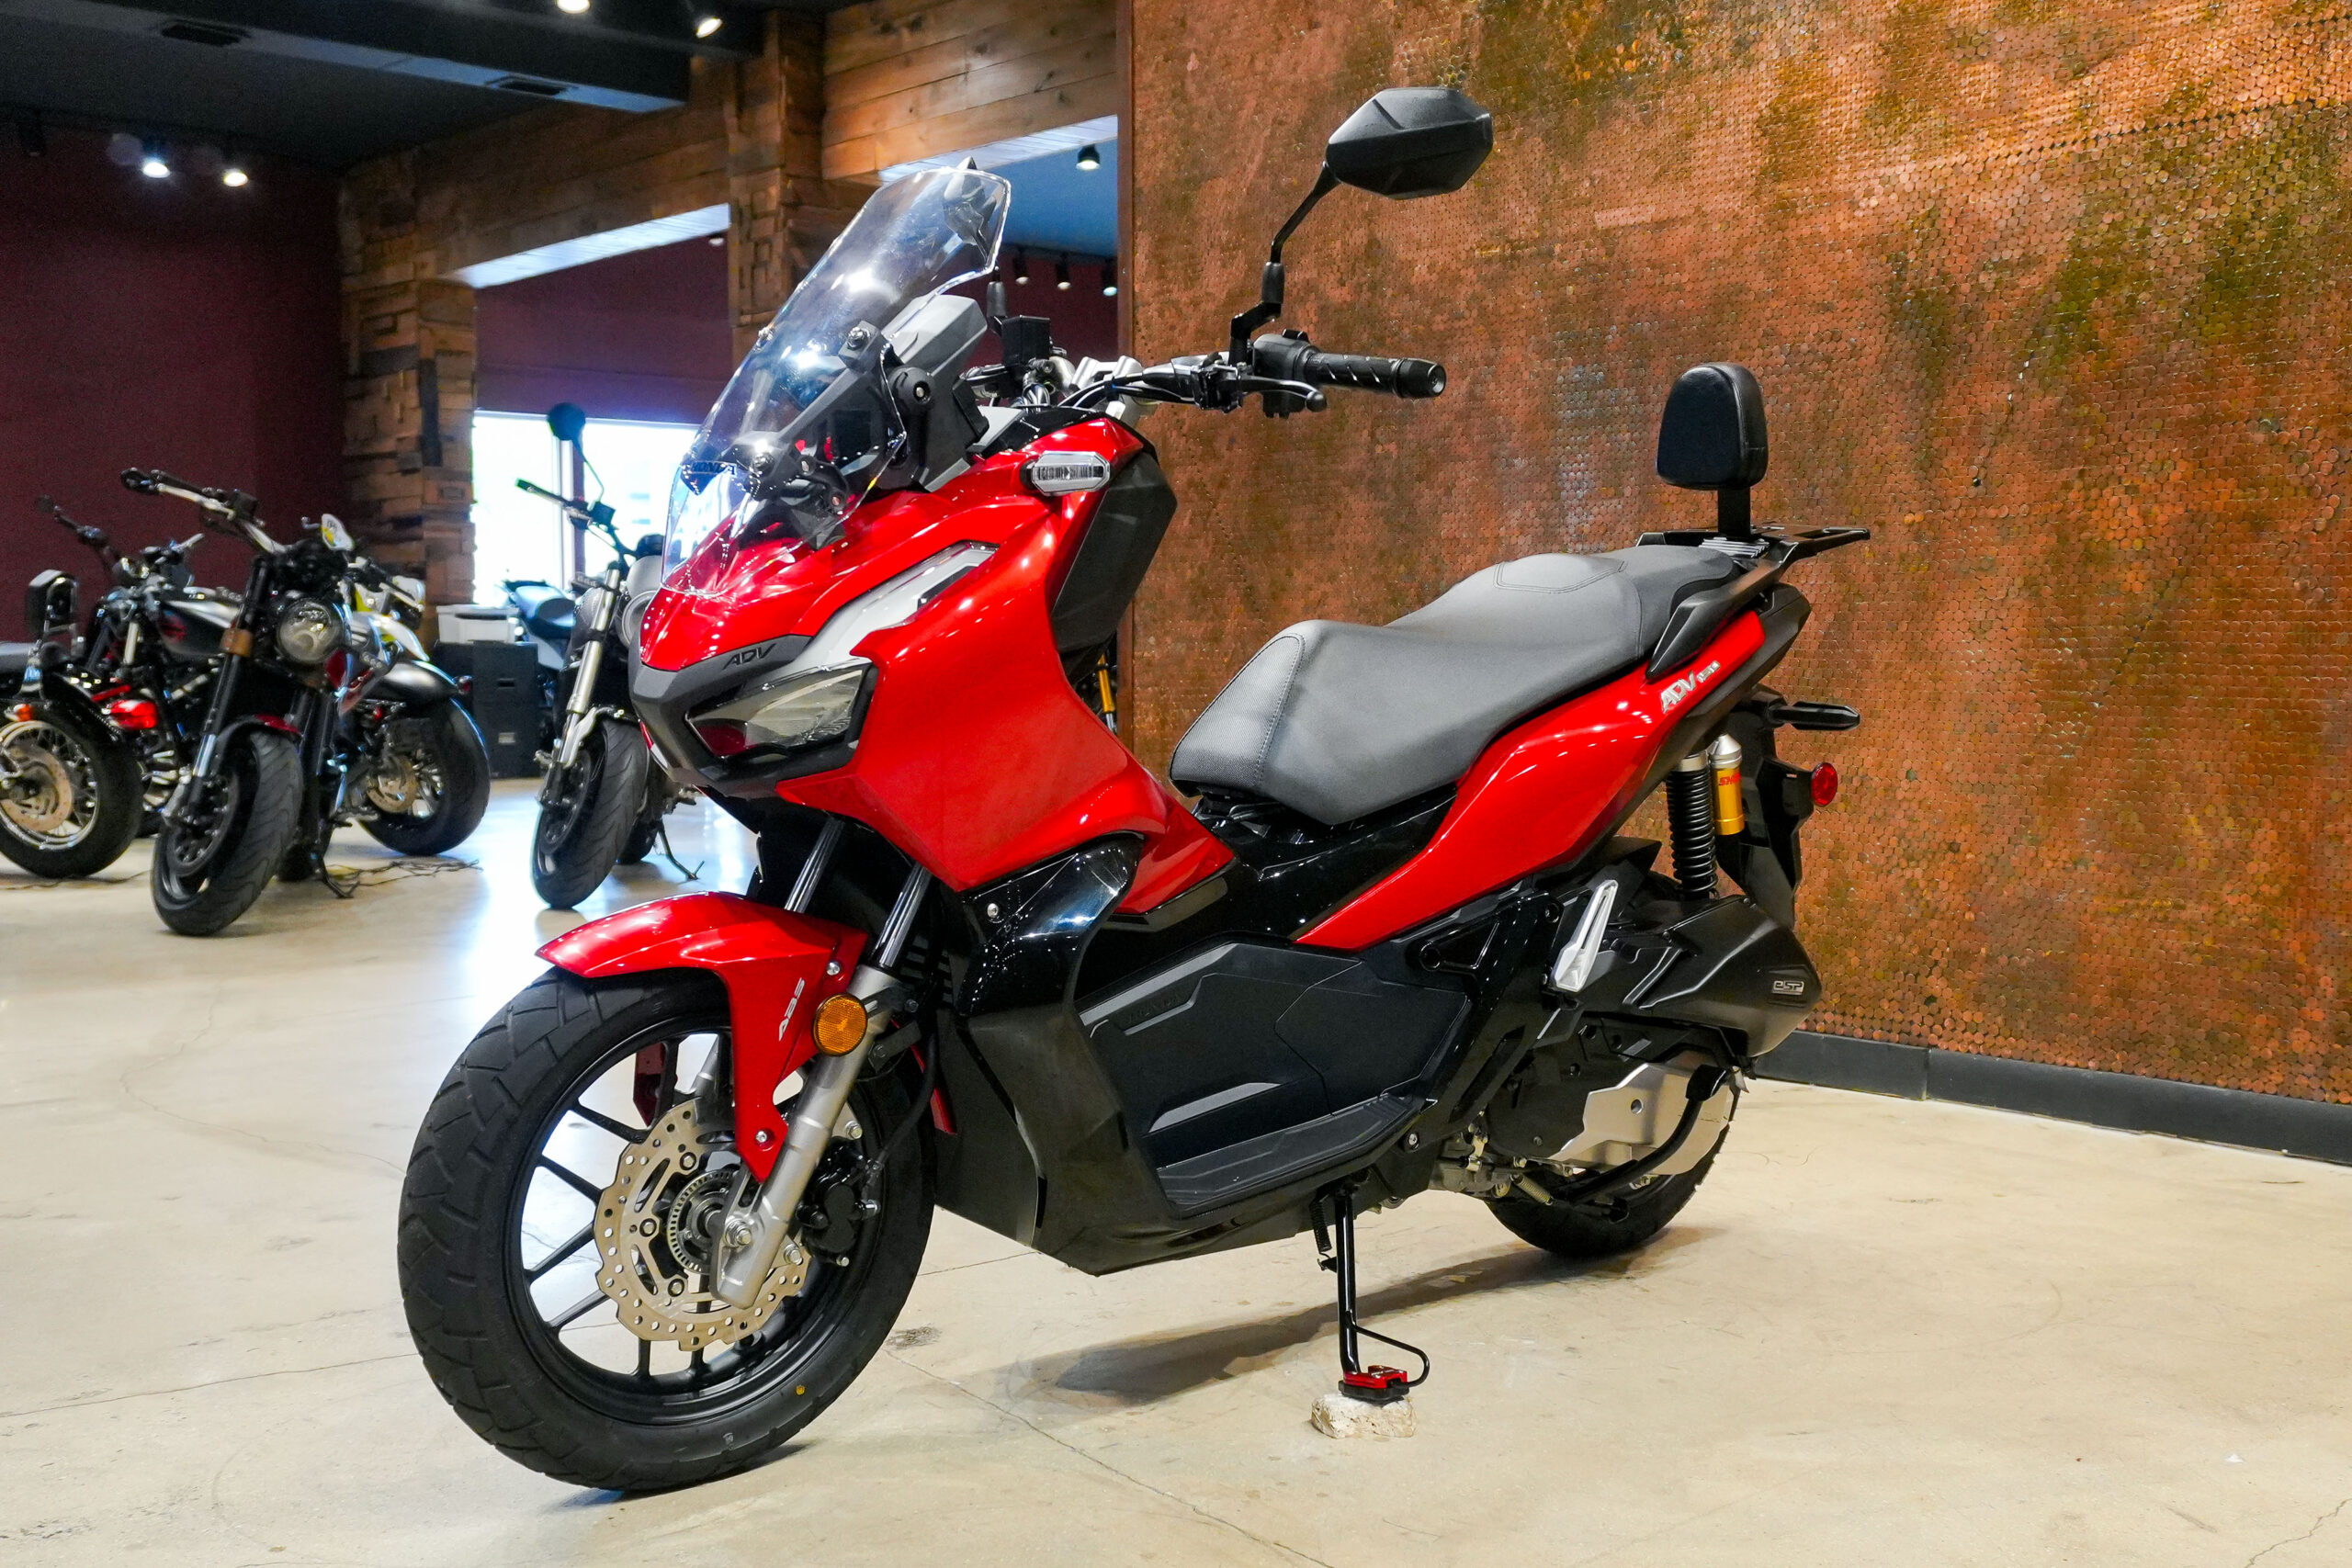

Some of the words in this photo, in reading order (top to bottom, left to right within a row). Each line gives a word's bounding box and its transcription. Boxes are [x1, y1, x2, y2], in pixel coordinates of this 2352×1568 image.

[722, 643, 777, 670] ADV
[1660, 671, 1696, 714] ADV
[778, 976, 806, 1042] ABS
